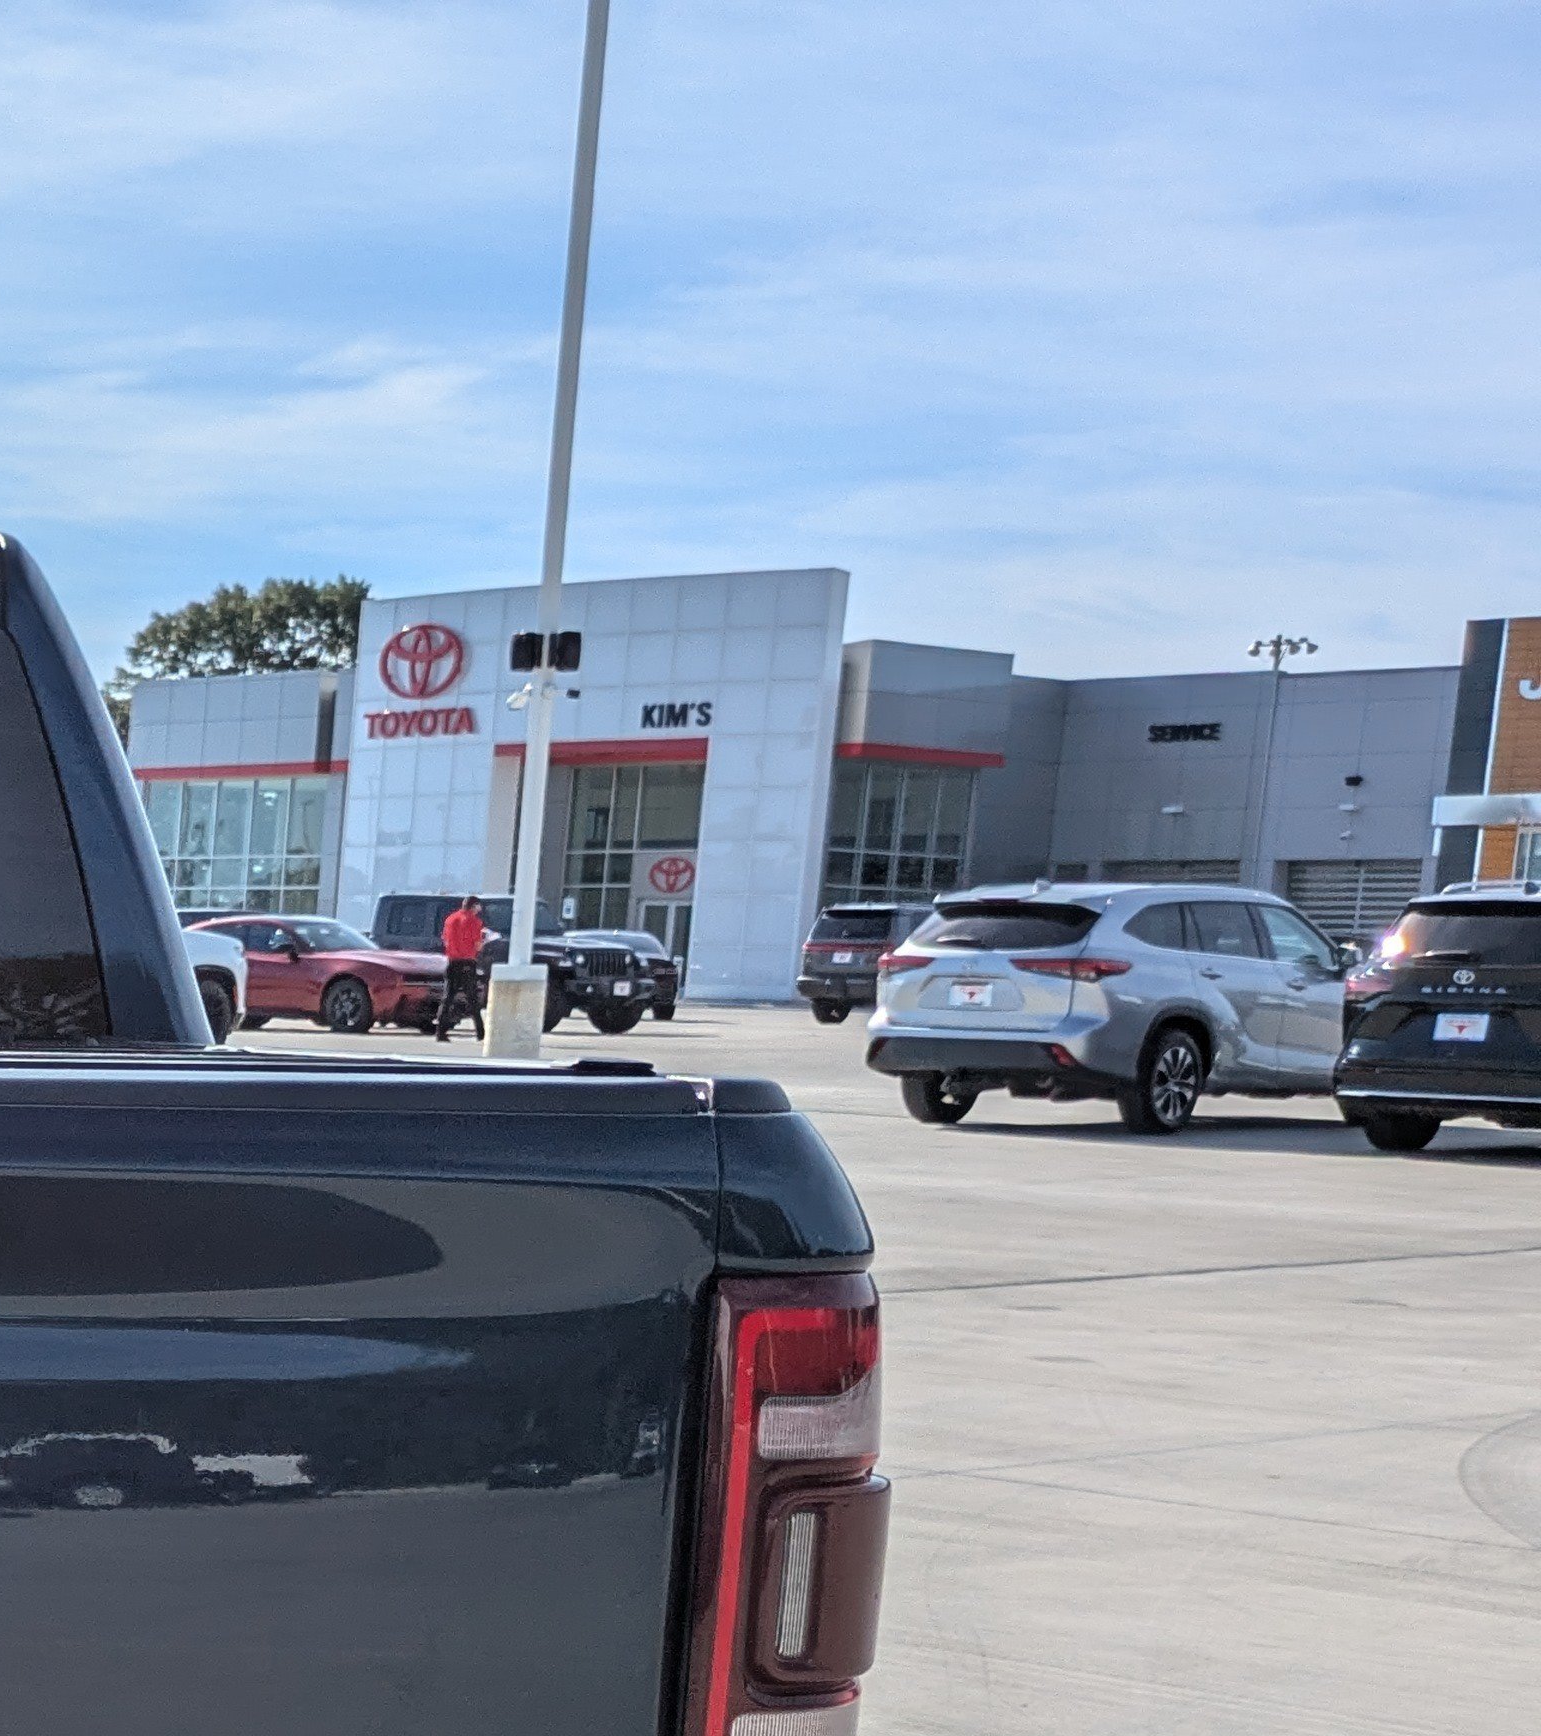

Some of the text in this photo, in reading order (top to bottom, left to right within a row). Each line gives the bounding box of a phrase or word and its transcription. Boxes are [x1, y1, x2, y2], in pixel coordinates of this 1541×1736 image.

[364, 706, 477, 740] TOYOTA
[640, 701, 713, 729] KIM'S
[1147, 723, 1221, 742] SERVICE
